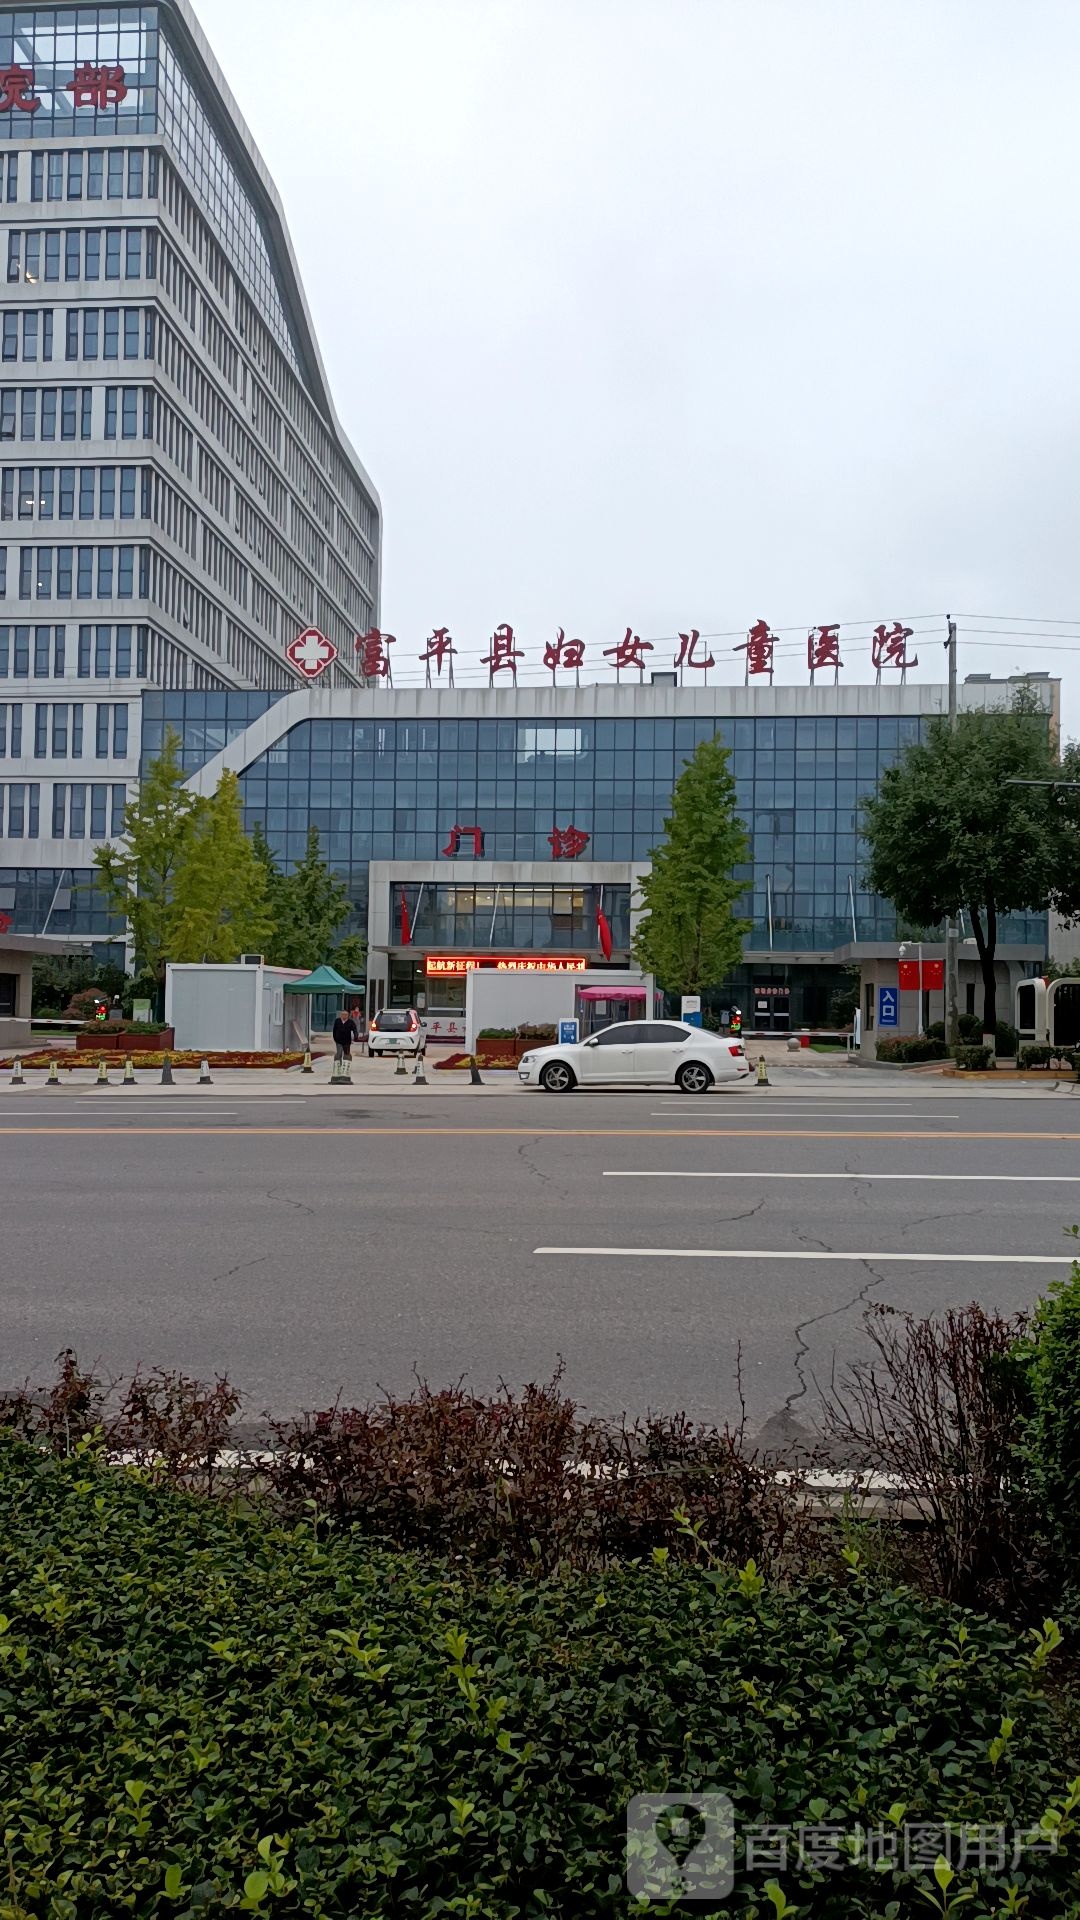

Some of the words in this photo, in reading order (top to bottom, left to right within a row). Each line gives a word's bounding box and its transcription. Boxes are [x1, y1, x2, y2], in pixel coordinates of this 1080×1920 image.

[355, 619, 918, 678] 富平县妇女儿童医院
[442, 824, 590, 858] 门诊
[882, 990, 895, 1017] 入口
[431, 1021, 466, 1033] 平县
